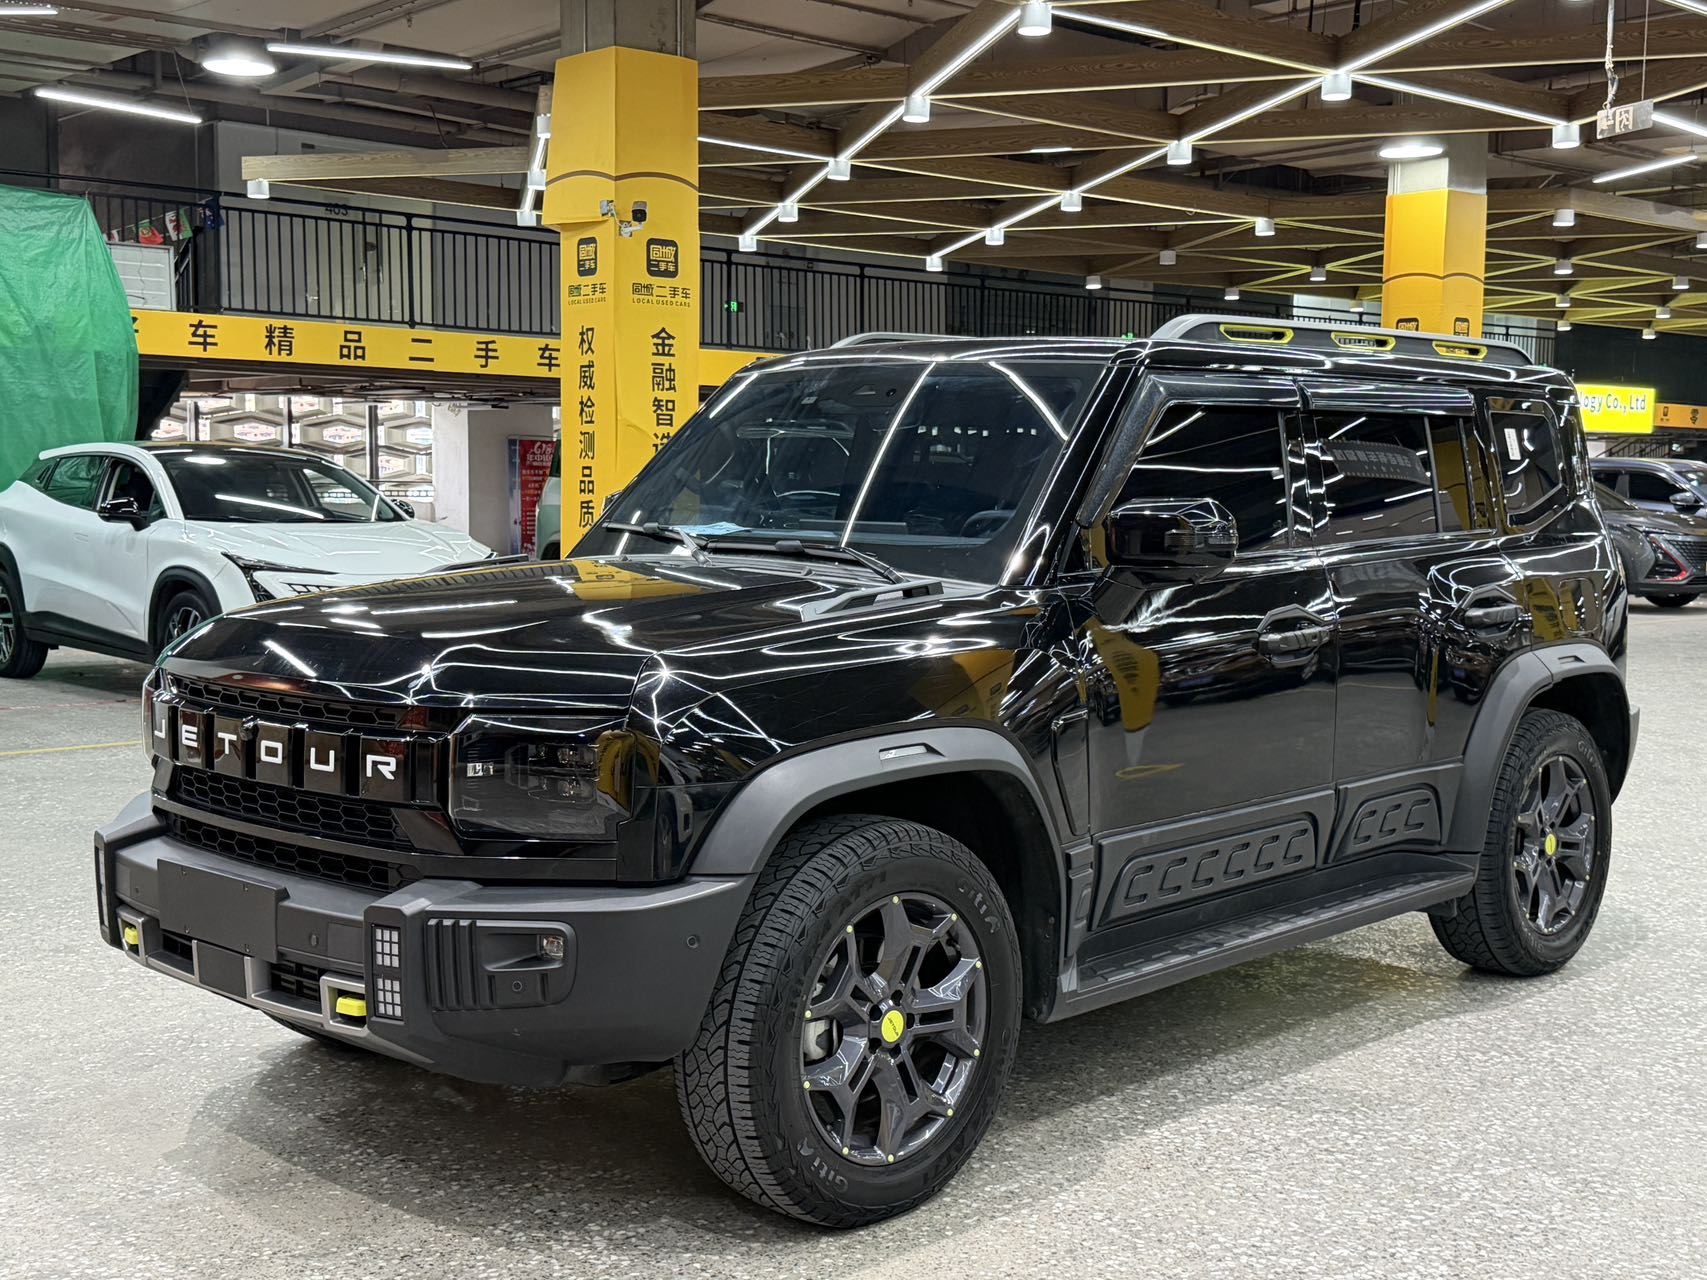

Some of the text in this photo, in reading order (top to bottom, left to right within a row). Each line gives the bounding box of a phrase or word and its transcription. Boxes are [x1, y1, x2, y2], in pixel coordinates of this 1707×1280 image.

[650, 261, 676, 272] 二手车
[632, 282, 691, 300] 同城二手车
[632, 297, 691, 308] LOCAL USED CARS
[131, 316, 560, 372] 车精品二手车
[1629, 394, 1647, 411] Ltd
[578, 325, 596, 528] 权威检测品质
[154, 718, 397, 780] JETOUR
[810, 1156, 849, 1193] Giti
